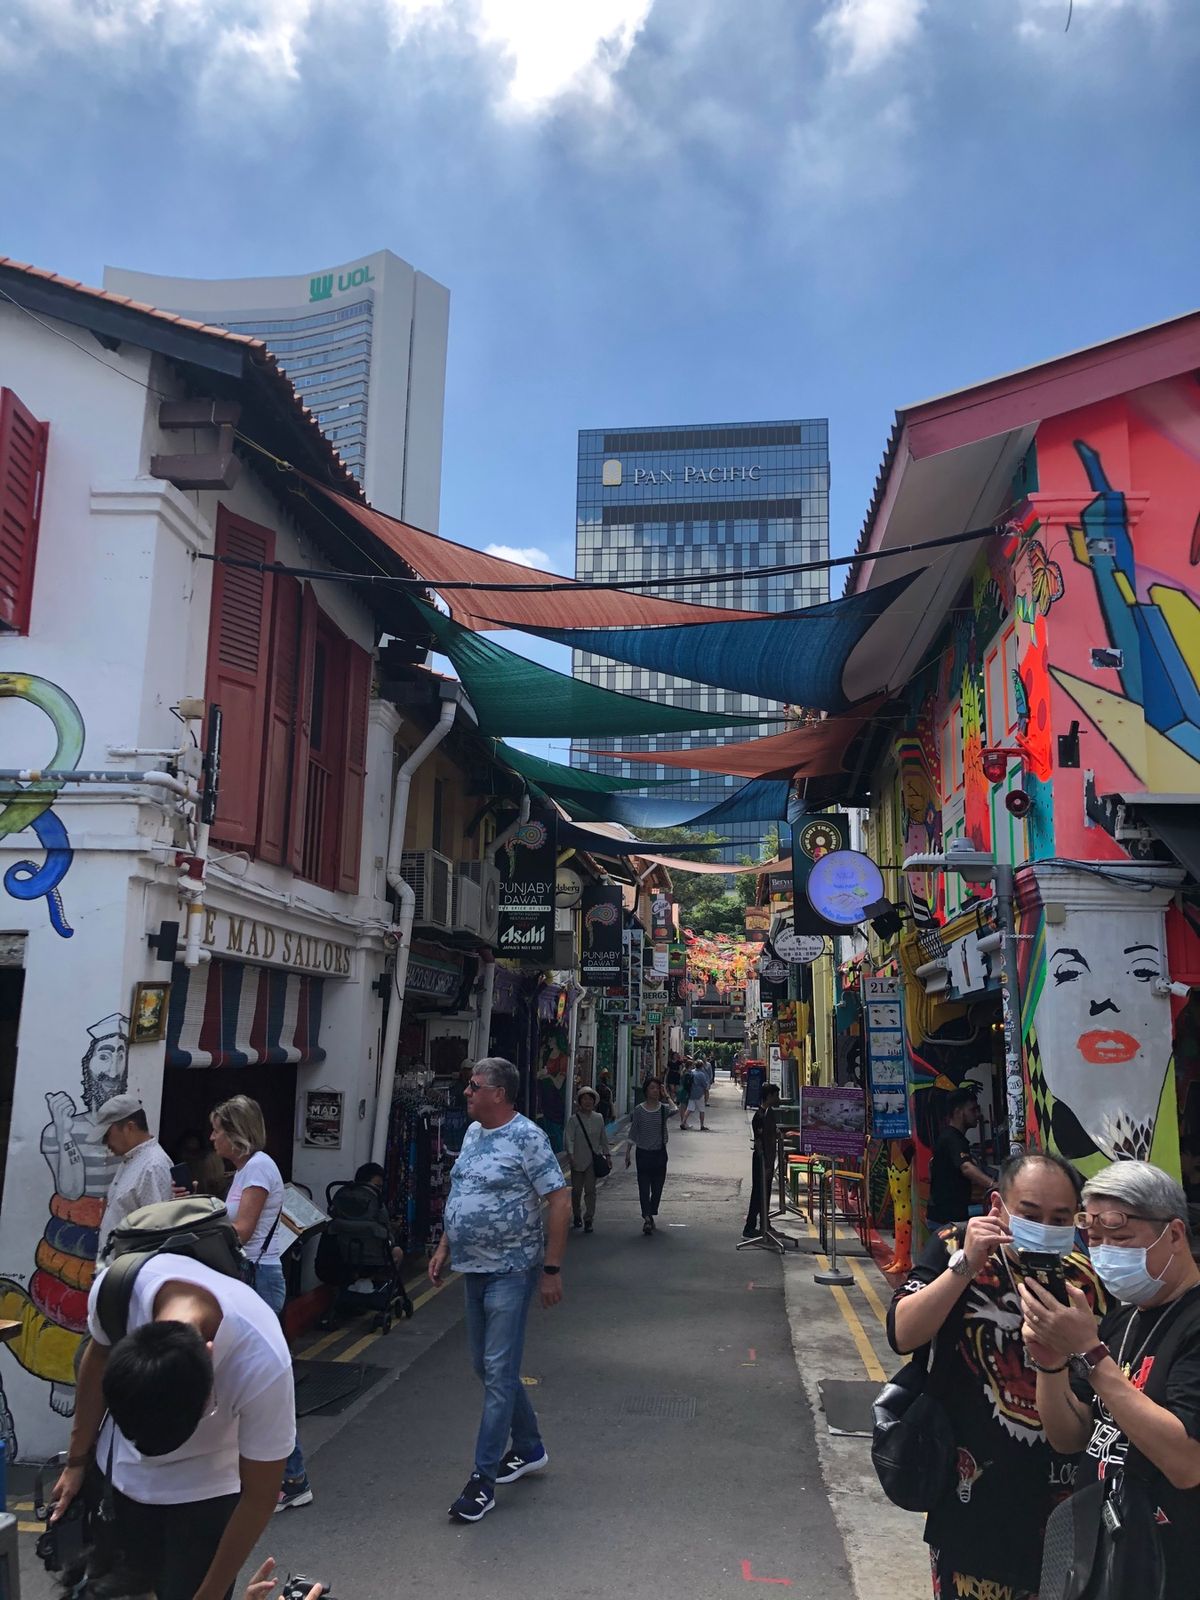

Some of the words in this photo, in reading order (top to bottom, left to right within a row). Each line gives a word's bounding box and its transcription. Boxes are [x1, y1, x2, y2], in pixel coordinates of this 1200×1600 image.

[338, 266, 375, 291] UOL
[634, 468, 673, 485] PAN
[684, 465, 761, 483] PACIFIC
[499, 882, 553, 896] PUNJABY
[504, 895, 545, 905] DAWAT
[500, 925, 546, 944] Asahi
[227, 916, 276, 958] MAD
[283, 931, 352, 974] SAILORS
[582, 951, 620, 961] PUNJABY
[871, 982, 896, 993] 21A
[643, 991, 668, 1000] BERGS
[311, 1105, 338, 1116] MAD
